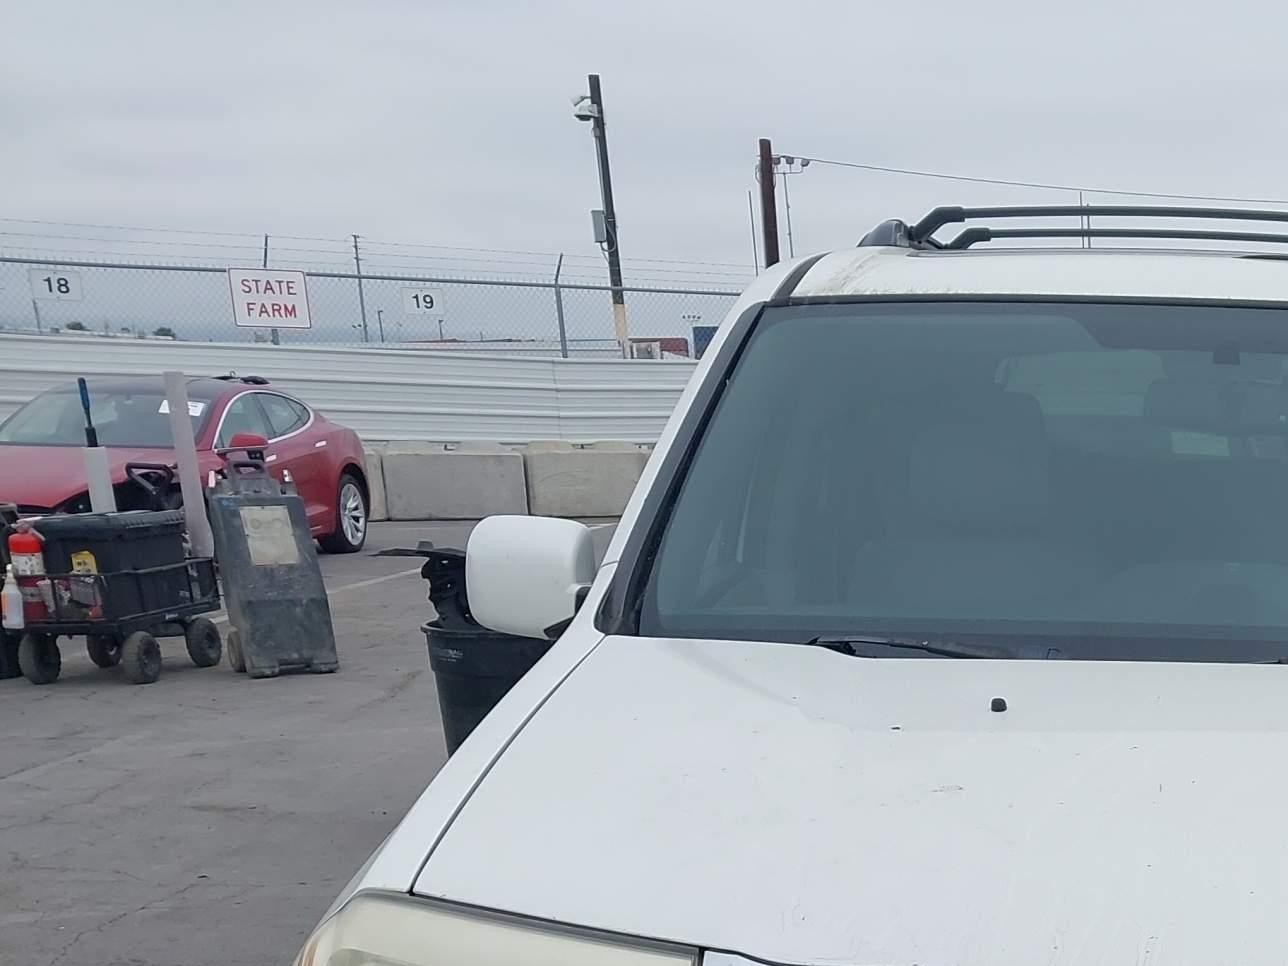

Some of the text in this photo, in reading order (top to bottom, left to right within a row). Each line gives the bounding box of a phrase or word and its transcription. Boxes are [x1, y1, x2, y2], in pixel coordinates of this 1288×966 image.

[43, 276, 70, 295] 18
[240, 279, 297, 296] STATE
[246, 302, 298, 319] FARM
[411, 294, 435, 310] 19
